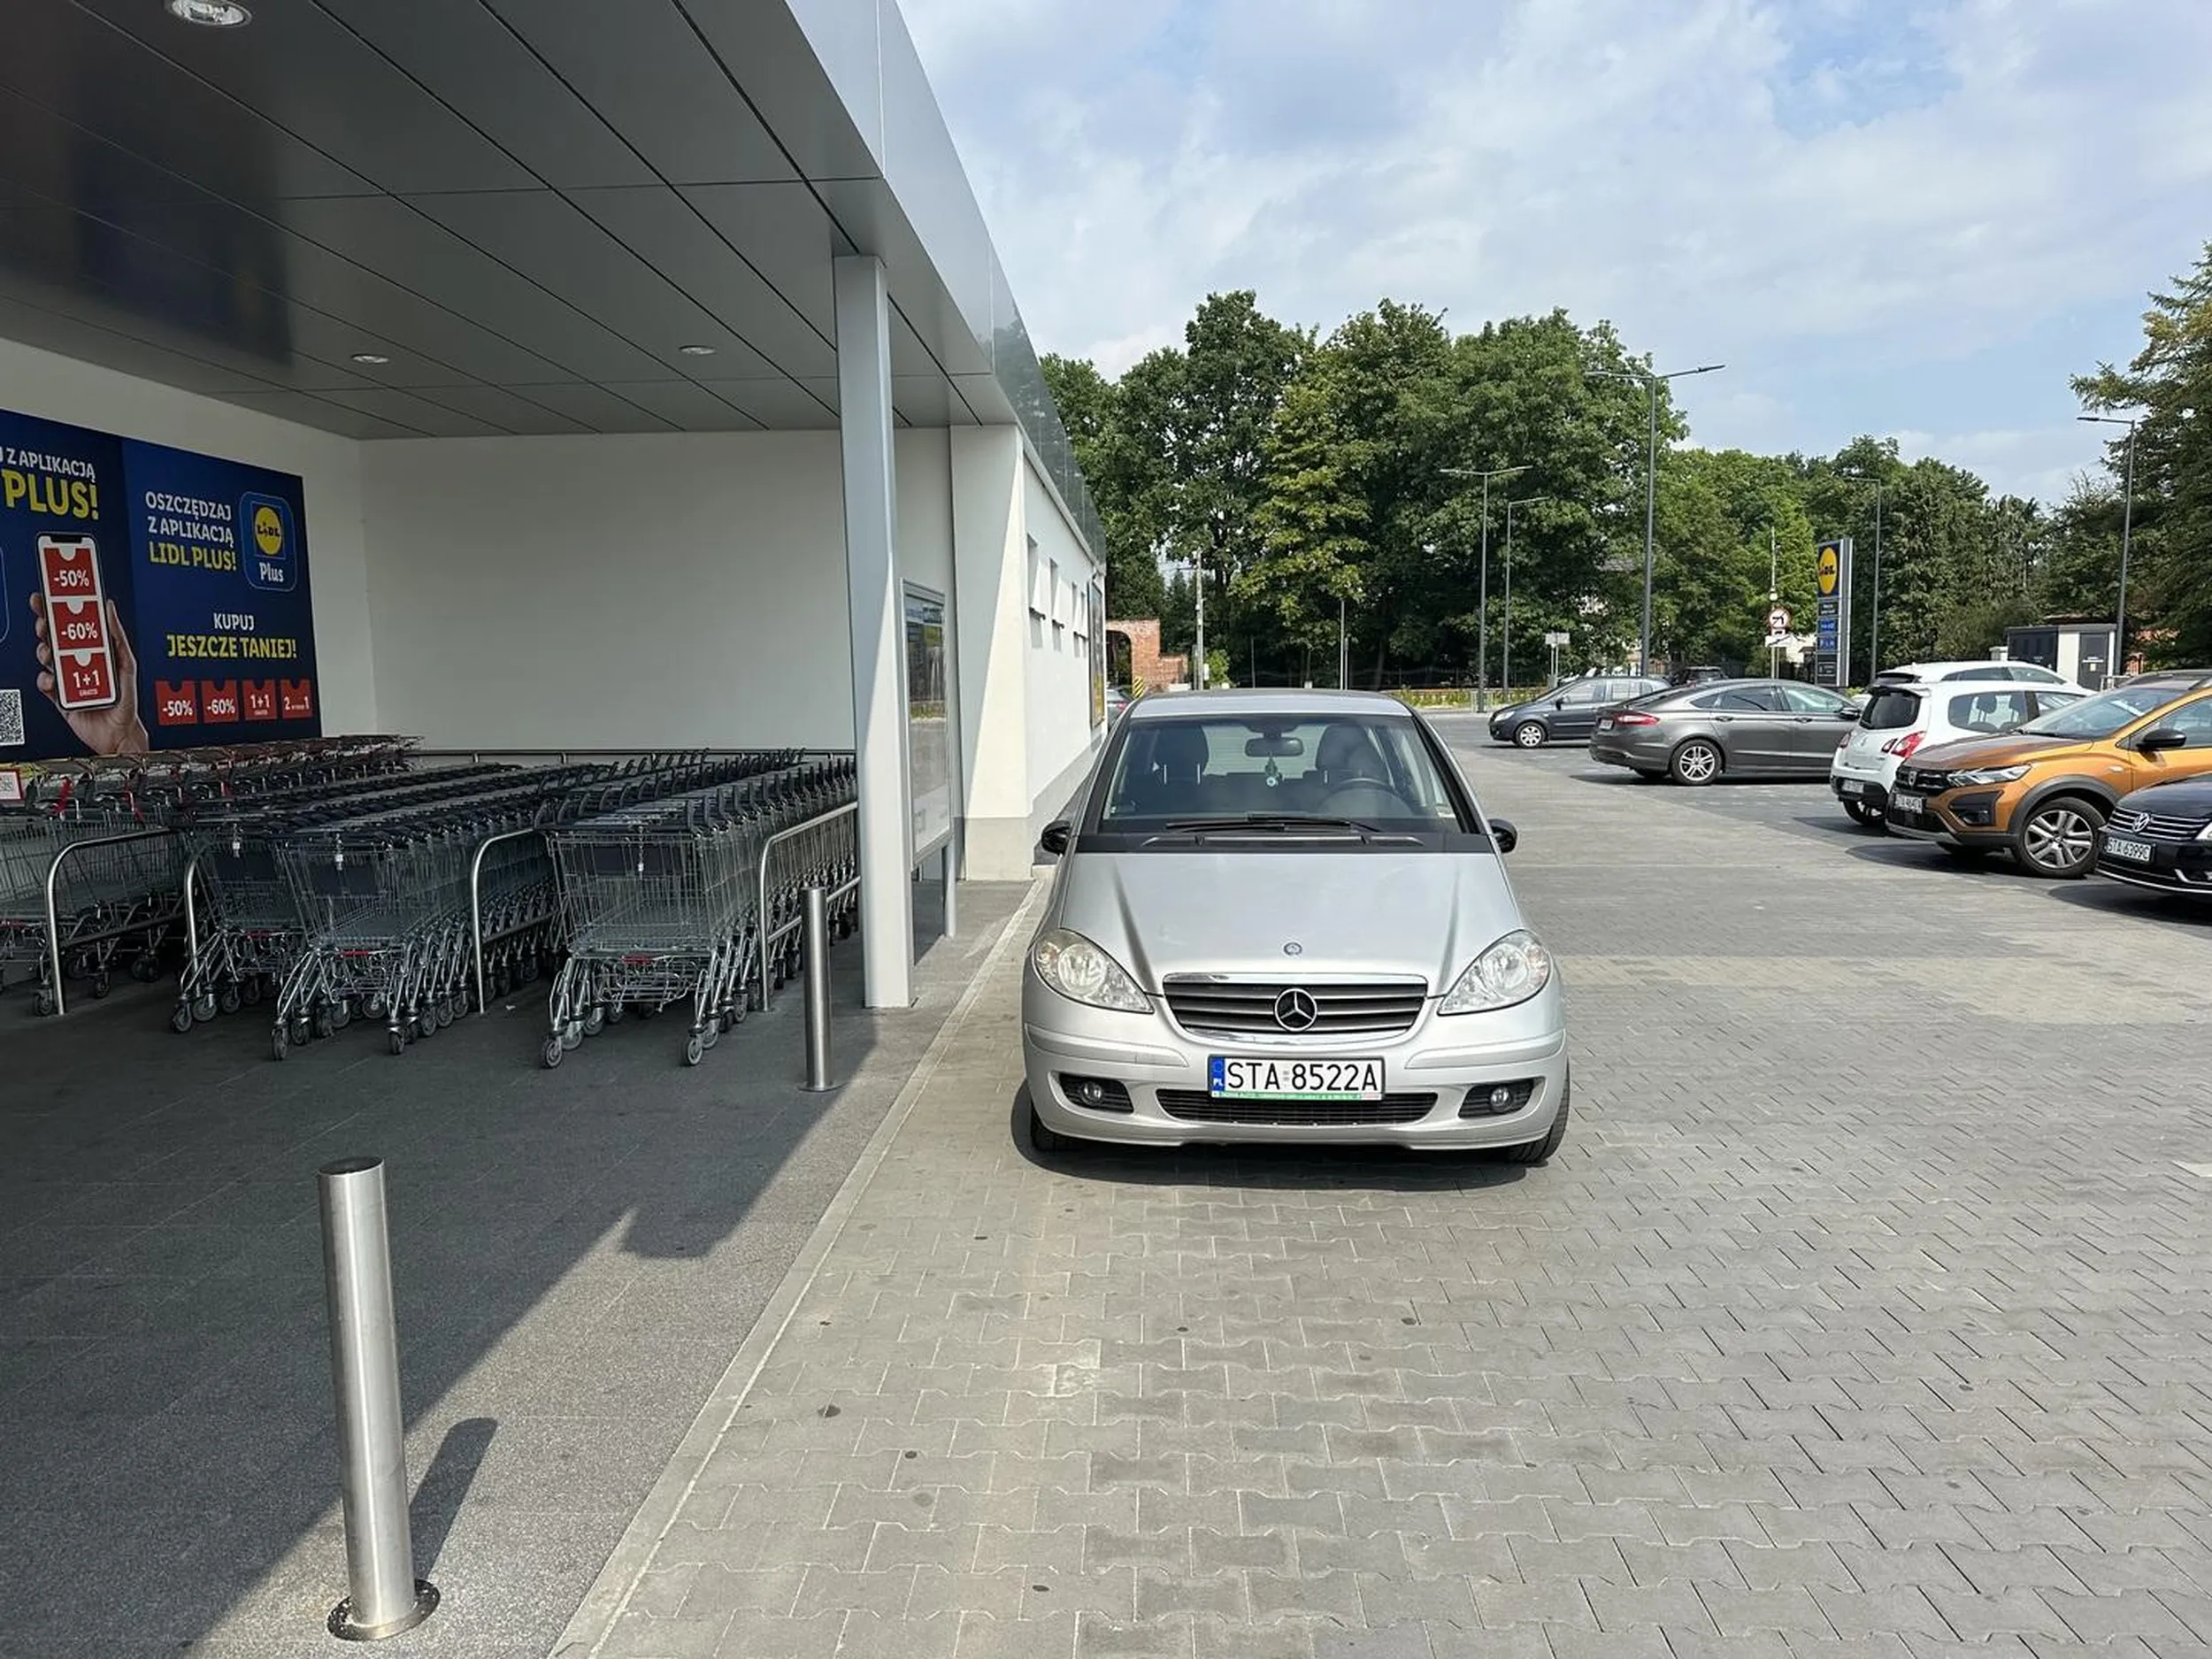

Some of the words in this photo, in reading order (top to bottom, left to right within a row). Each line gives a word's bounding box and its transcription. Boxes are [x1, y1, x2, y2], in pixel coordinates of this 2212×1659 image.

[6, 448, 16, 465] Z
[19, 450, 96, 482] APLIKACJĄ
[1, 468, 99, 520] PLUS!
[145, 491, 232, 521] OSZCZĘDZAJ
[147, 516, 157, 534] Z
[160, 517, 234, 548] APLIKACJĄ
[149, 541, 189, 565] LIDL
[192, 546, 237, 571] PLUS!
[53, 568, 89, 588] -50%
[258, 562, 284, 582] Plus
[61, 622, 98, 641] -60%
[213, 612, 255, 630] KUPUJ
[166, 634, 238, 657] JESZCZE
[239, 637, 297, 658] TANIEJ!
[73, 670, 100, 688] 1+1
[163, 700, 193, 717] -50%
[207, 698, 235, 714] -60%
[1227, 1062, 1280, 1090] STA
[1292, 1063, 1378, 1091] 8522A
